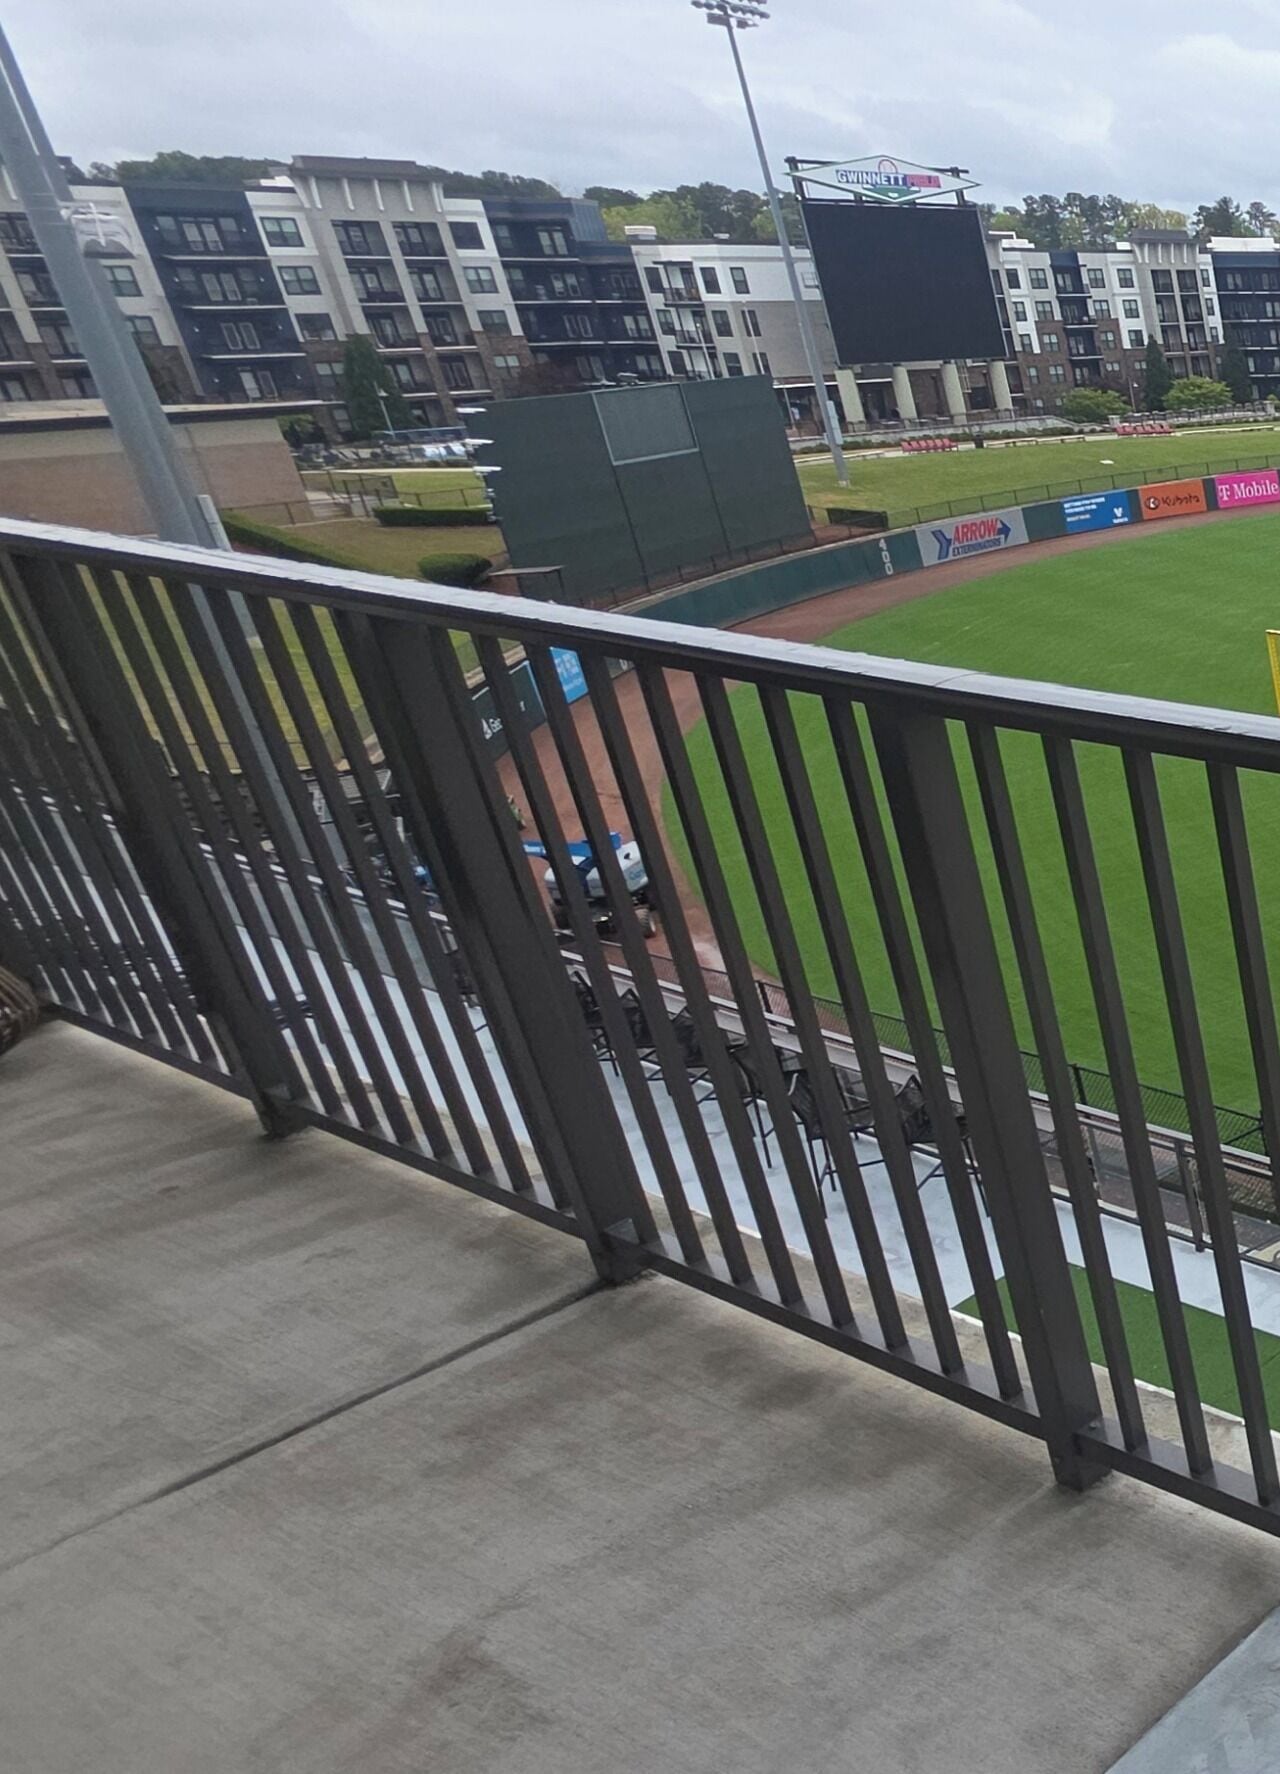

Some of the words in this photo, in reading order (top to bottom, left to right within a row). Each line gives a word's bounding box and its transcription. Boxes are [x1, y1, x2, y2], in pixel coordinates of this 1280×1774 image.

[837, 169, 905, 186] GWINNETT
[1162, 493, 1200, 507] Kubota
[953, 516, 998, 546] ARROW
[878, 537, 894, 576] 400
